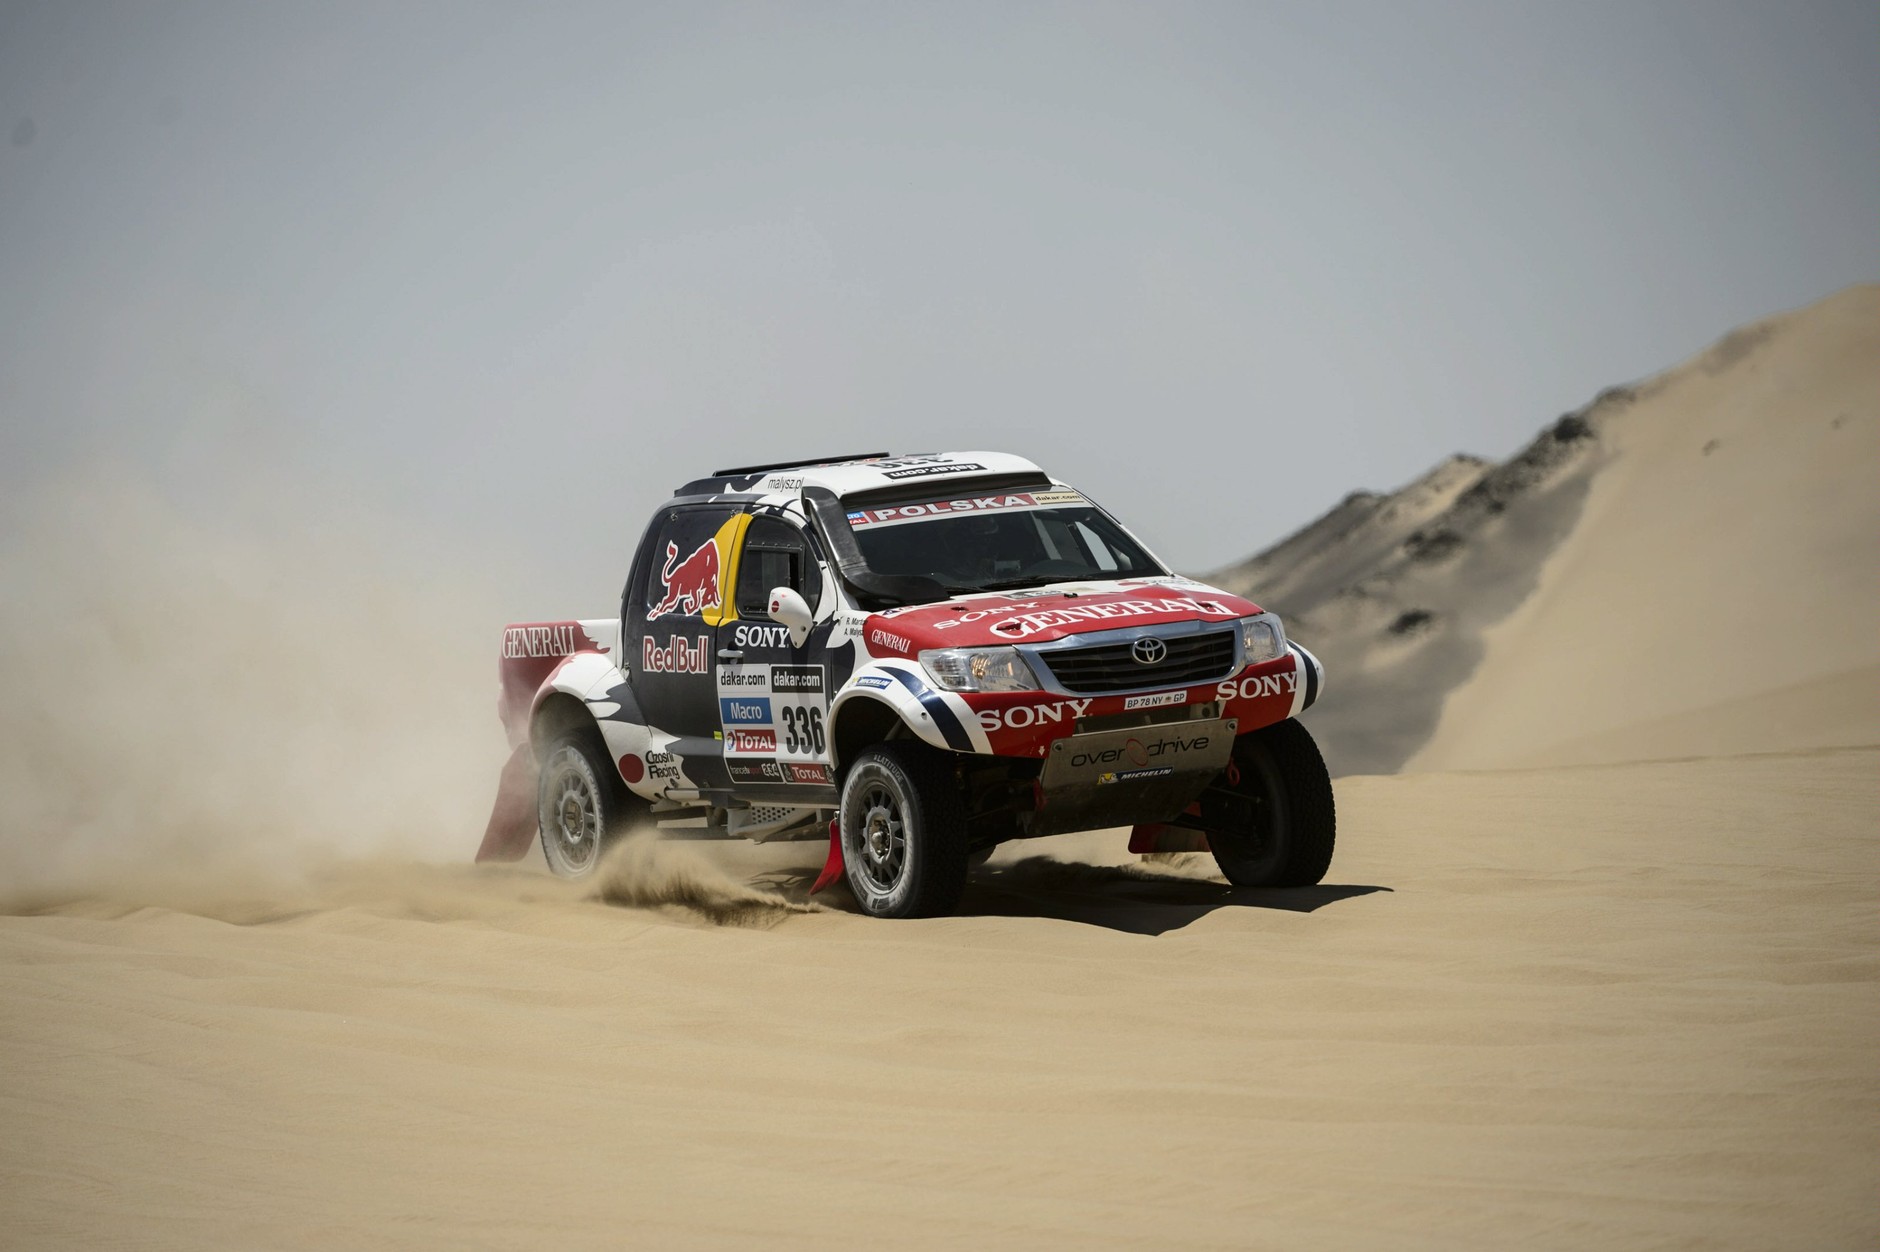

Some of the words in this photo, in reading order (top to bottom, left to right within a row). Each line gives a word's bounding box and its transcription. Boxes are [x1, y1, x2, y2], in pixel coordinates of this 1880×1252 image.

[890, 463, 979, 478] dakar.com
[873, 495, 1026, 521] POLSKA
[934, 602, 1039, 630] SONY
[989, 598, 1240, 639] GENERALI
[503, 626, 575, 658] GENERALI
[735, 626, 790, 648] SONY
[871, 629, 911, 653] GENERALI
[721, 672, 766, 686] dakar.com
[774, 671, 820, 687] dakar.com
[1215, 671, 1297, 702] SONY
[730, 702, 762, 719] Macro
[1127, 699, 1139, 708] BP
[1140, 698, 1150, 706] 78
[1152, 696, 1163, 705] NY
[1173, 693, 1185, 702] GP
[976, 699, 1093, 732] SONY
[782, 706, 826, 754] 336
[648, 763, 680, 779] Racing
[792, 767, 825, 780] TOTAL
[1121, 768, 1172, 780] MICHELIN
